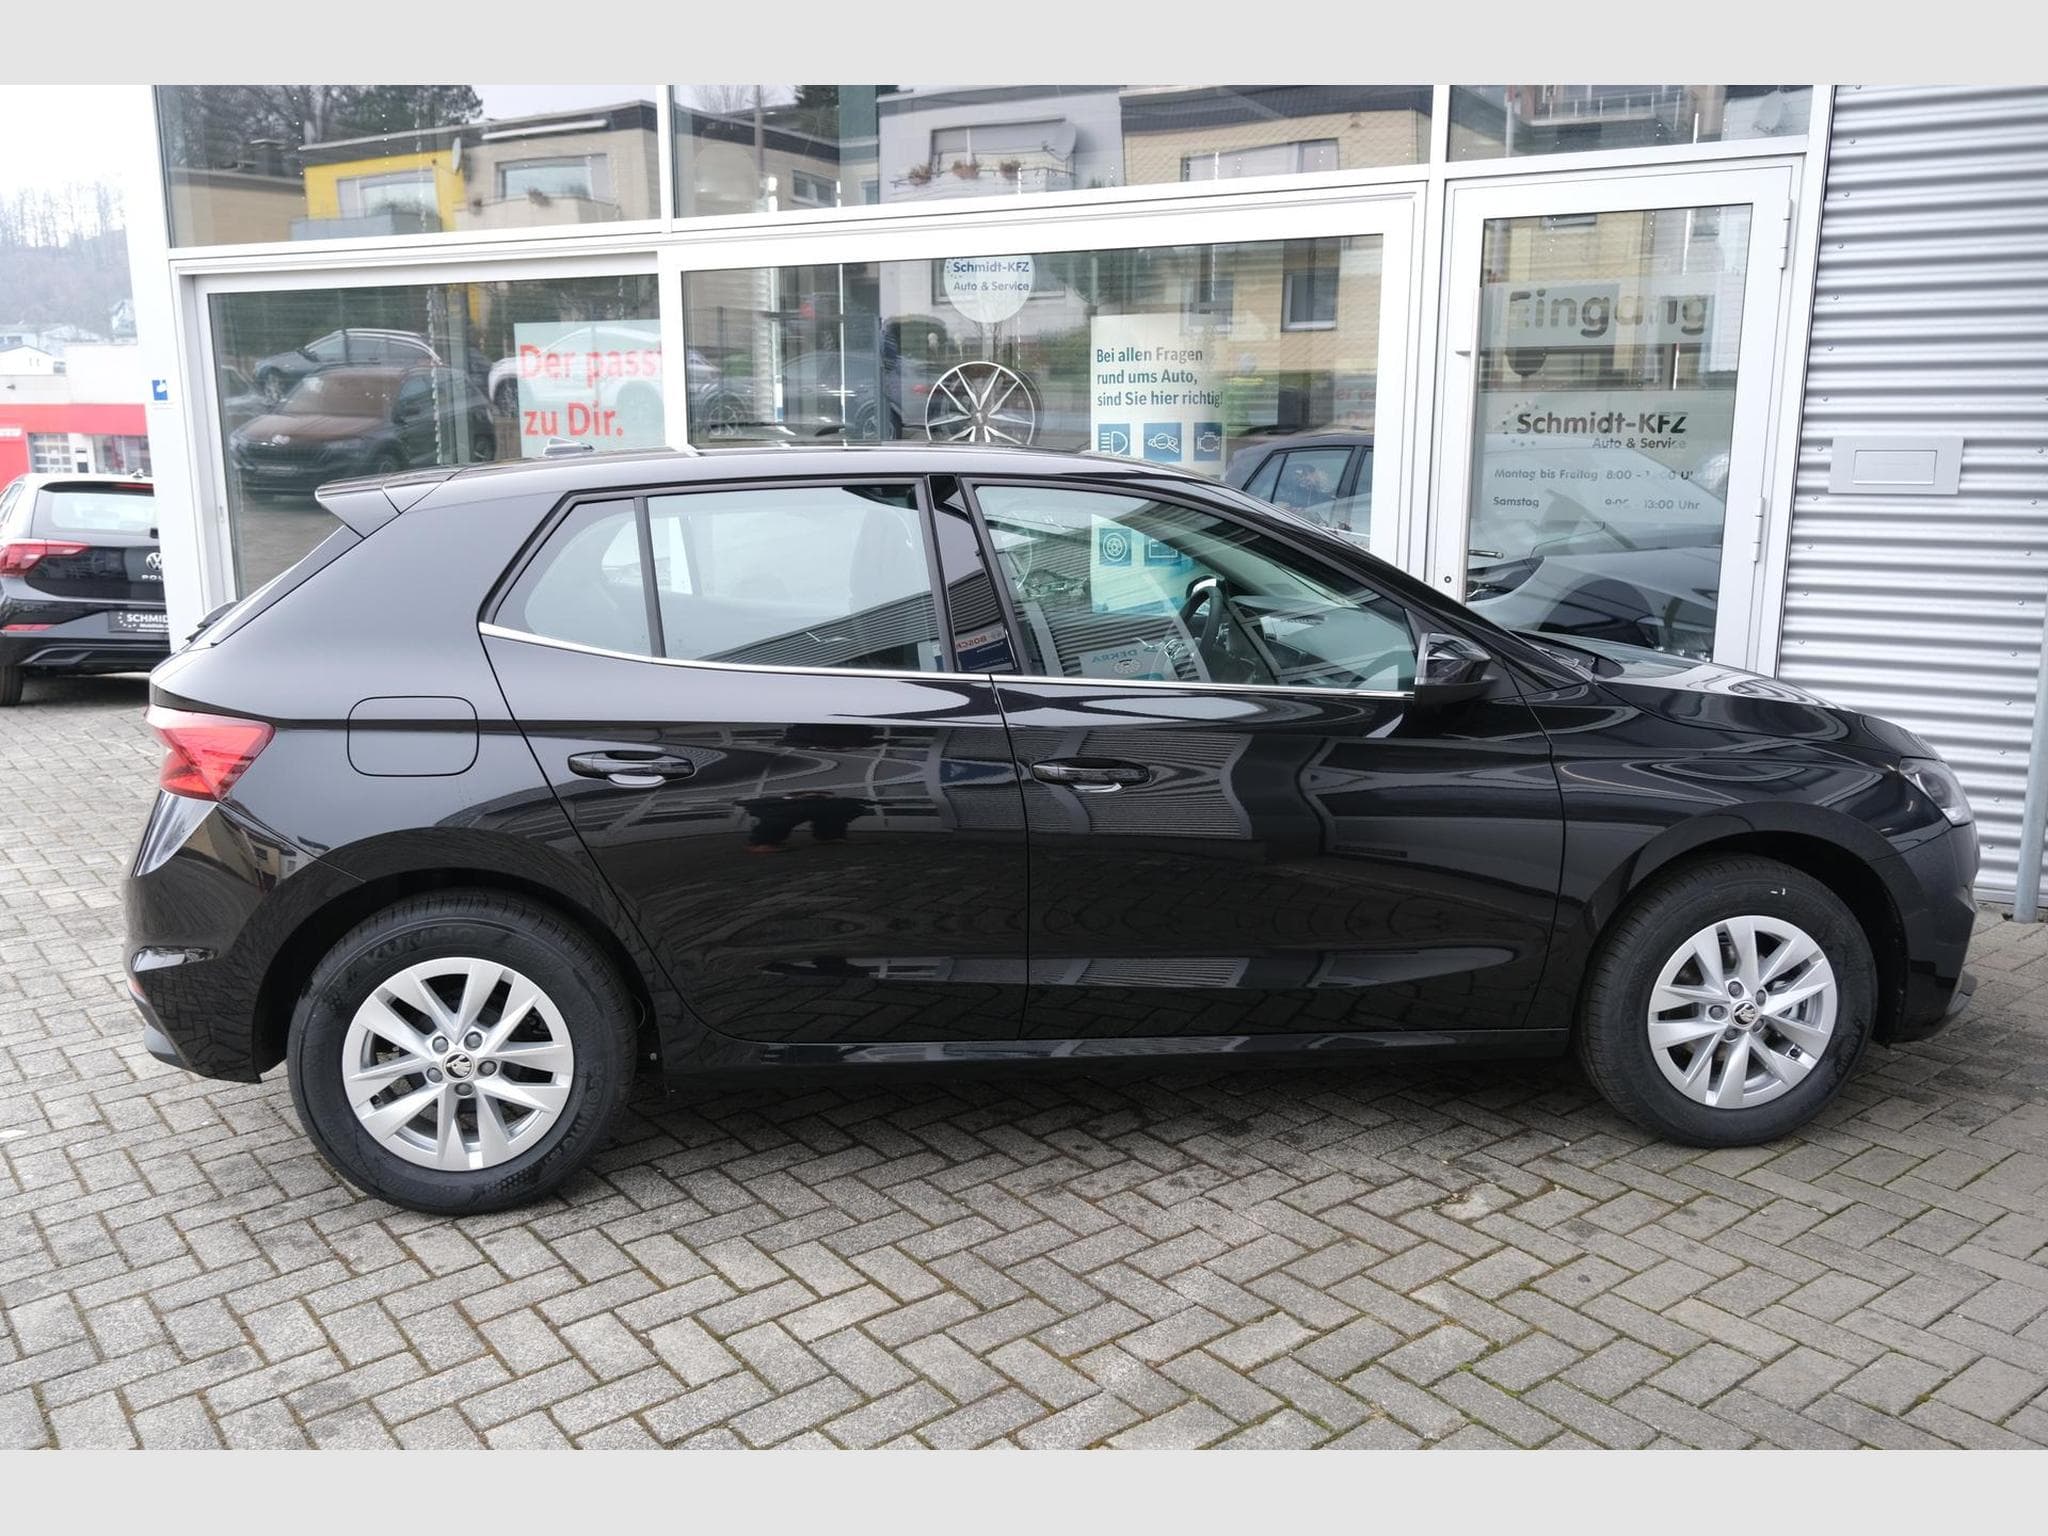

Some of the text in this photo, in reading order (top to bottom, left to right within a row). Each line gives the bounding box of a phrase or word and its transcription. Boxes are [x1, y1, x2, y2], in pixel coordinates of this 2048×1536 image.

[953, 261, 1030, 273] Schmidt-KFZ
[953, 281, 1030, 291] Auto & Service
[519, 344, 576, 379] Der
[1096, 346, 1203, 365] Bei allen Fragen
[1097, 369, 1198, 385] rund ums Auto,
[1097, 390, 1223, 409] sind Sie hier richtig!
[523, 402, 625, 437] zu Dir.
[1516, 411, 1688, 434] Schmidt-KFZ
[1591, 437, 1622, 449] Auto
[1626, 437, 1636, 449] &
[1494, 469, 1536, 482] Montag
[1540, 469, 1557, 480] bis
[1559, 469, 1599, 482] Freitag
[1606, 469, 1632, 480] 8:00
[1492, 496, 1540, 509] Samstag
[1678, 499, 1701, 510] Uhr
[126, 613, 168, 623] SCHMID
